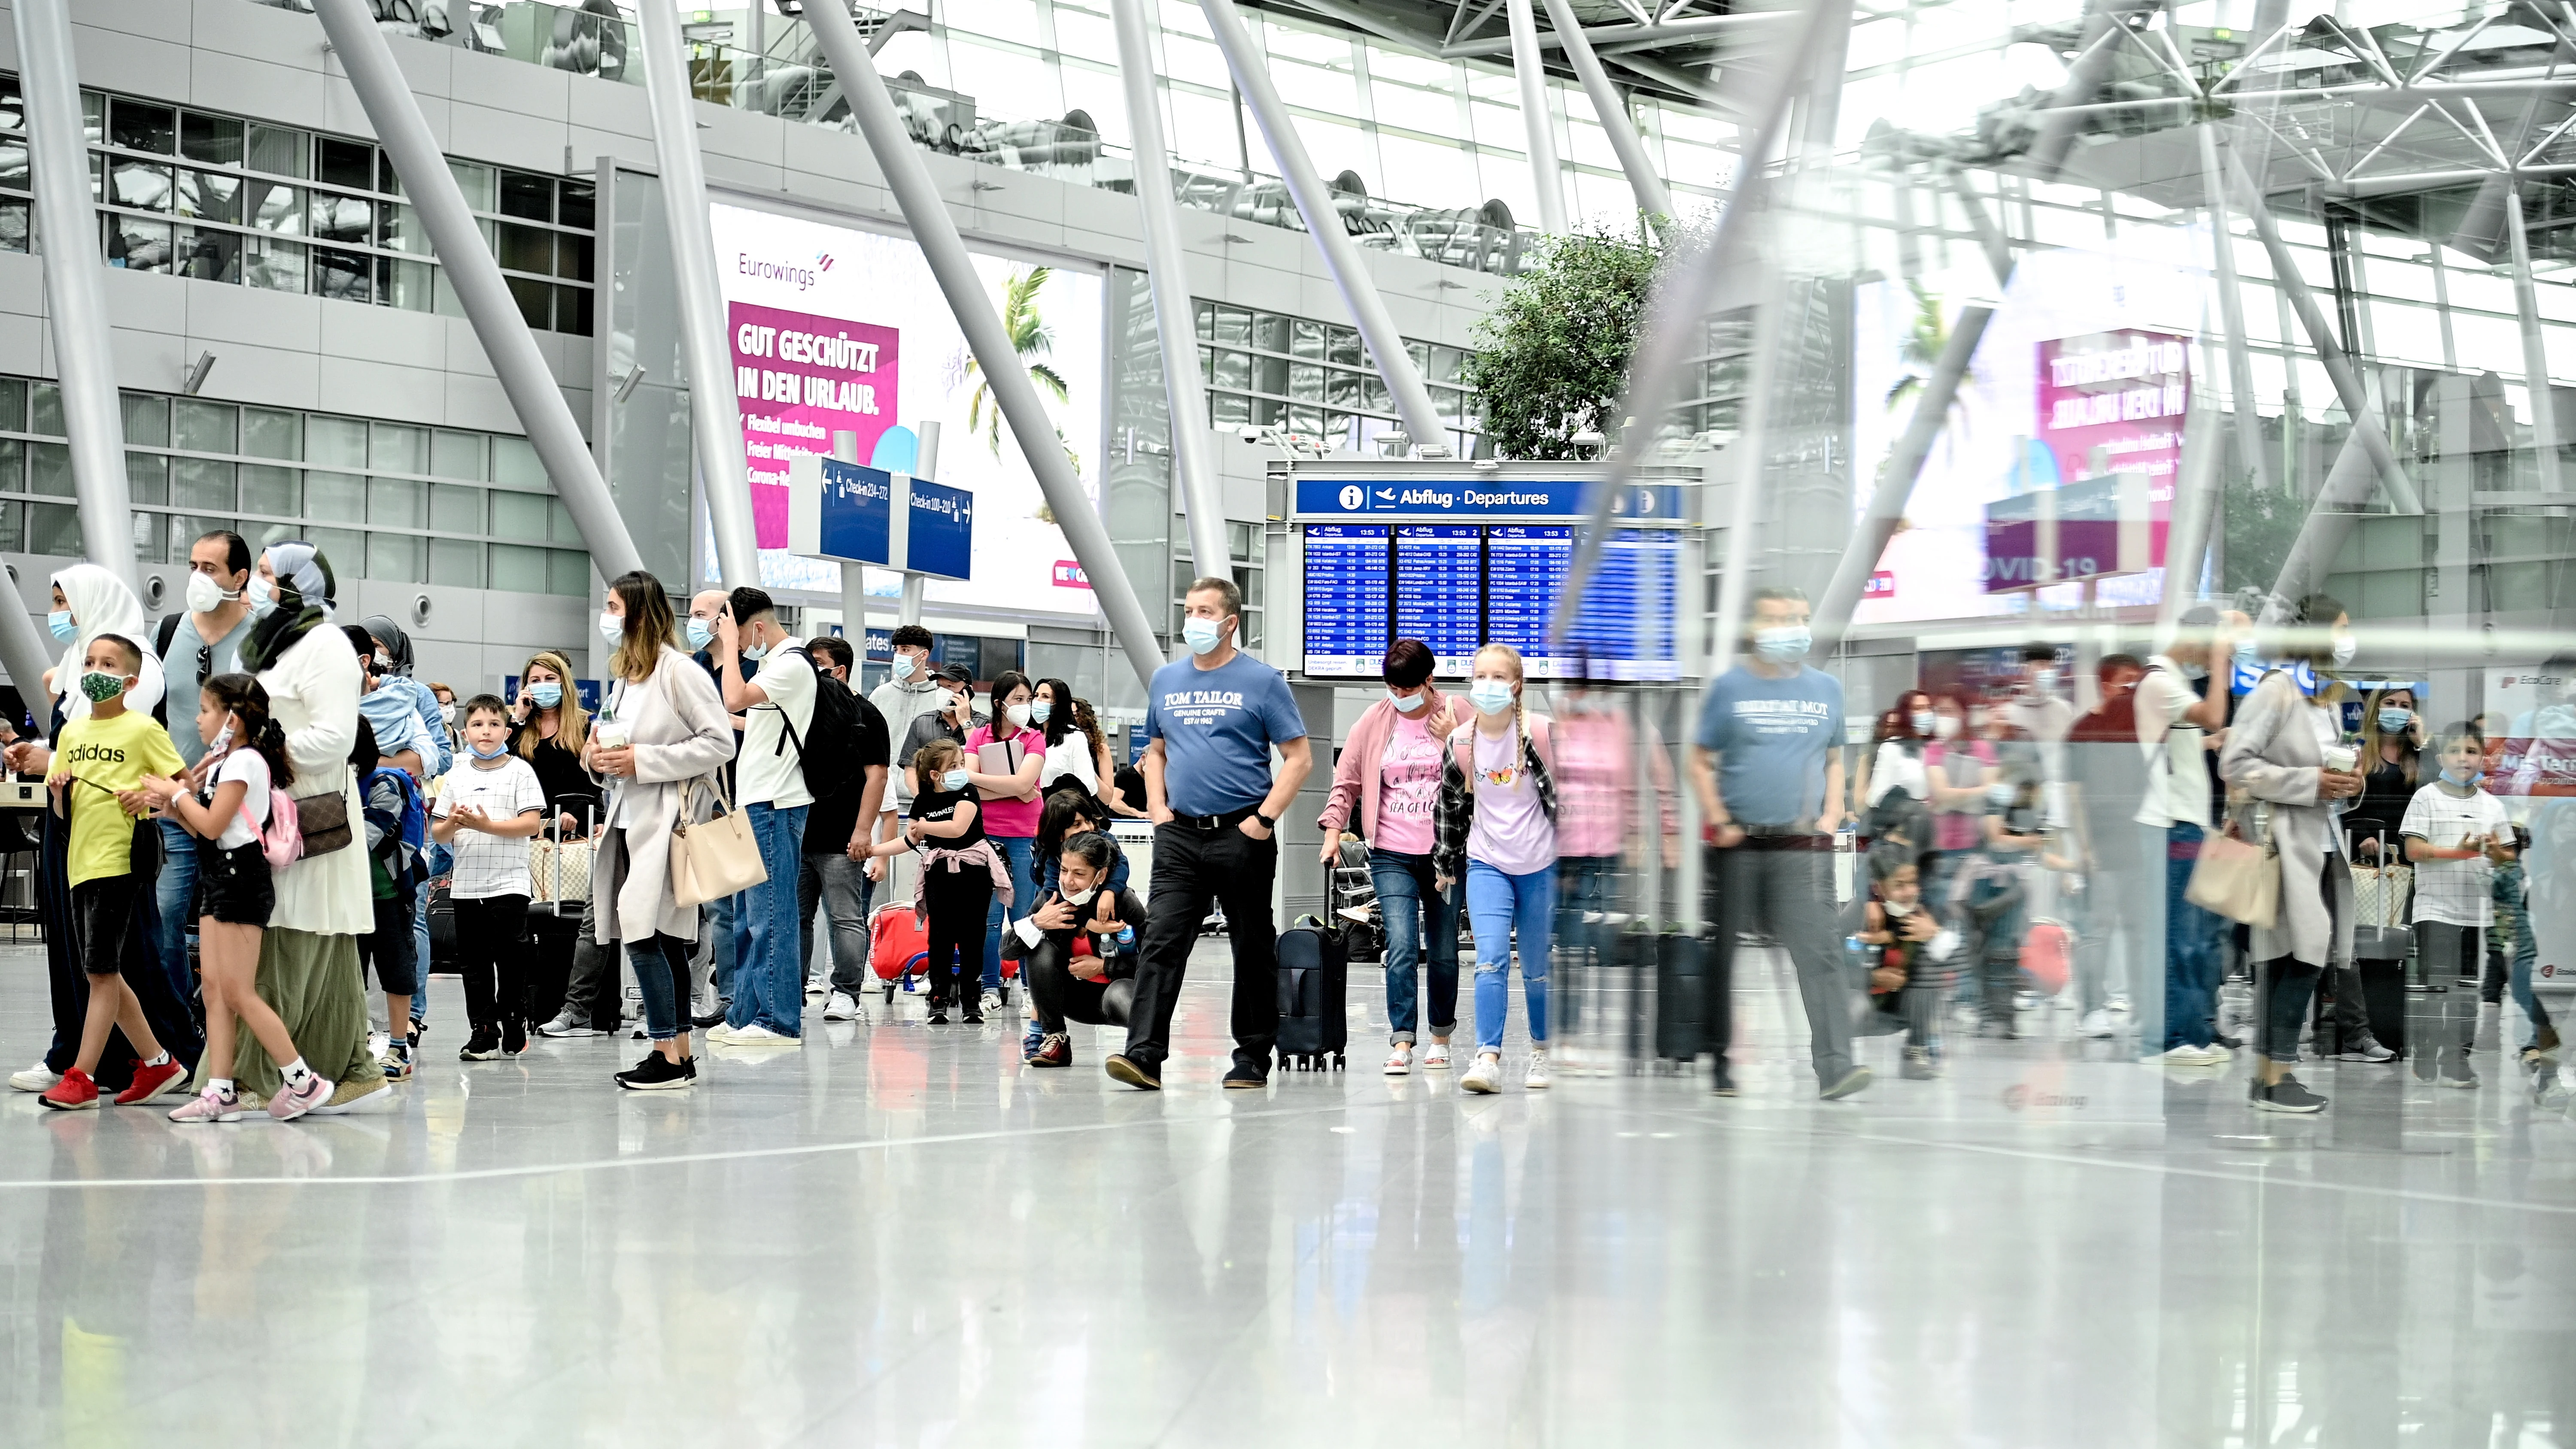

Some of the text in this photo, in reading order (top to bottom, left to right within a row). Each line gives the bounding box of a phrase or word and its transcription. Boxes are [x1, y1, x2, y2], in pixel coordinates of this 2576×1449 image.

[739, 253, 815, 291] Eurowings
[737, 323, 879, 374] GUT GESCHÜTZT
[737, 367, 880, 416] IN DEN URLAUB.
[747, 414, 826, 440] Flexibel umbuchen
[747, 440, 772, 459] Freier
[845, 478, 867, 496] Check-in
[910, 492, 930, 510] Check-in
[1400, 489, 1548, 508] Abflug Departures
[1055, 566, 1069, 581] WE
[1981, 557, 2098, 580] OVID-19
[866, 633, 889, 652] ates
[1164, 691, 1243, 707] TOM TAILOR
[67, 743, 125, 763] adidas
[1390, 802, 1404, 813] SEA
[1407, 802, 1420, 813] OF
